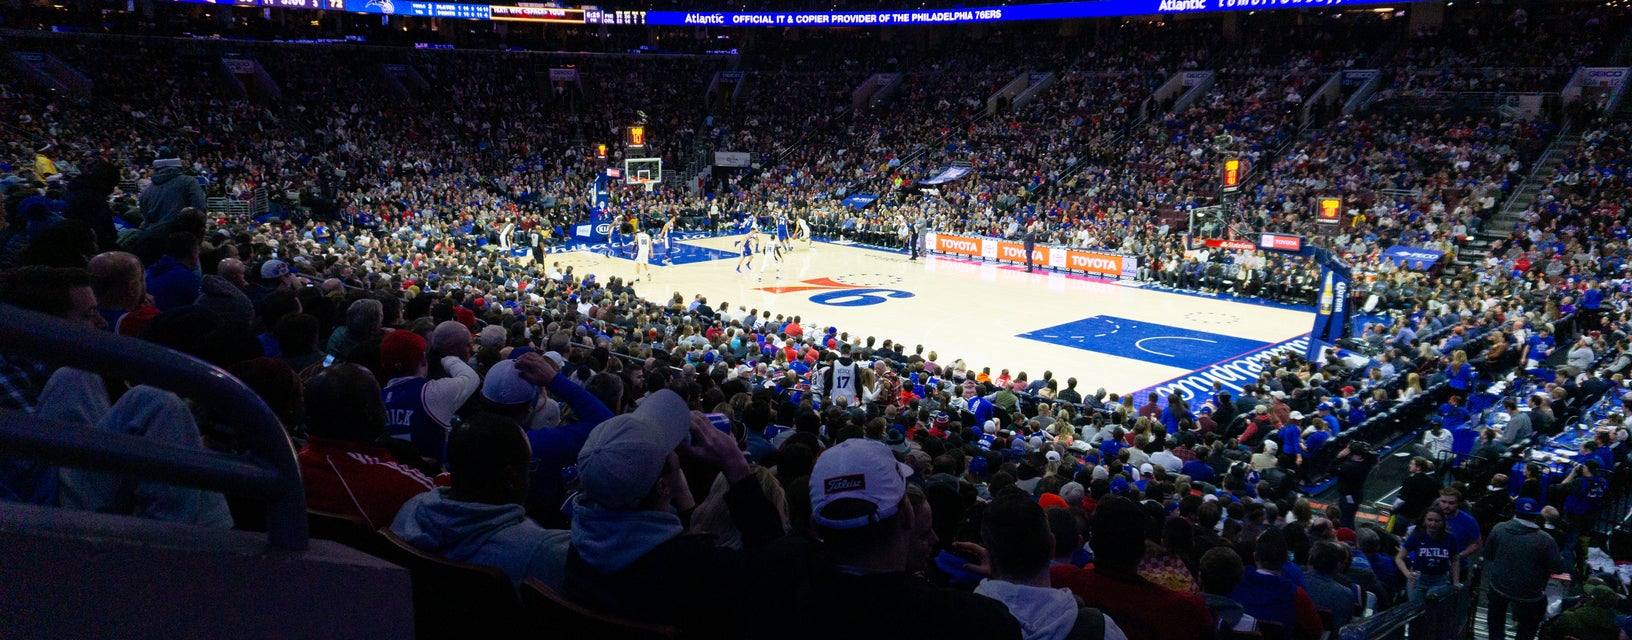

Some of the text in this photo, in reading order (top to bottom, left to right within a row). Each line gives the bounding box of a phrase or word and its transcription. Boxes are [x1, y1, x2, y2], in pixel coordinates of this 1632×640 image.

[1158, 0, 1206, 11] Atlantic
[685, 9, 1002, 24] Atlantic OFFICIAL IT & COPIER PROVIDER OF THE PHILADELPHIA 76ERS
[941, 238, 978, 252] TOYOTA
[1071, 255, 1117, 271] TOYOTA
[1334, 281, 1346, 313] Corona
[837, 376, 850, 389] 17
[827, 478, 863, 492] Titleist
